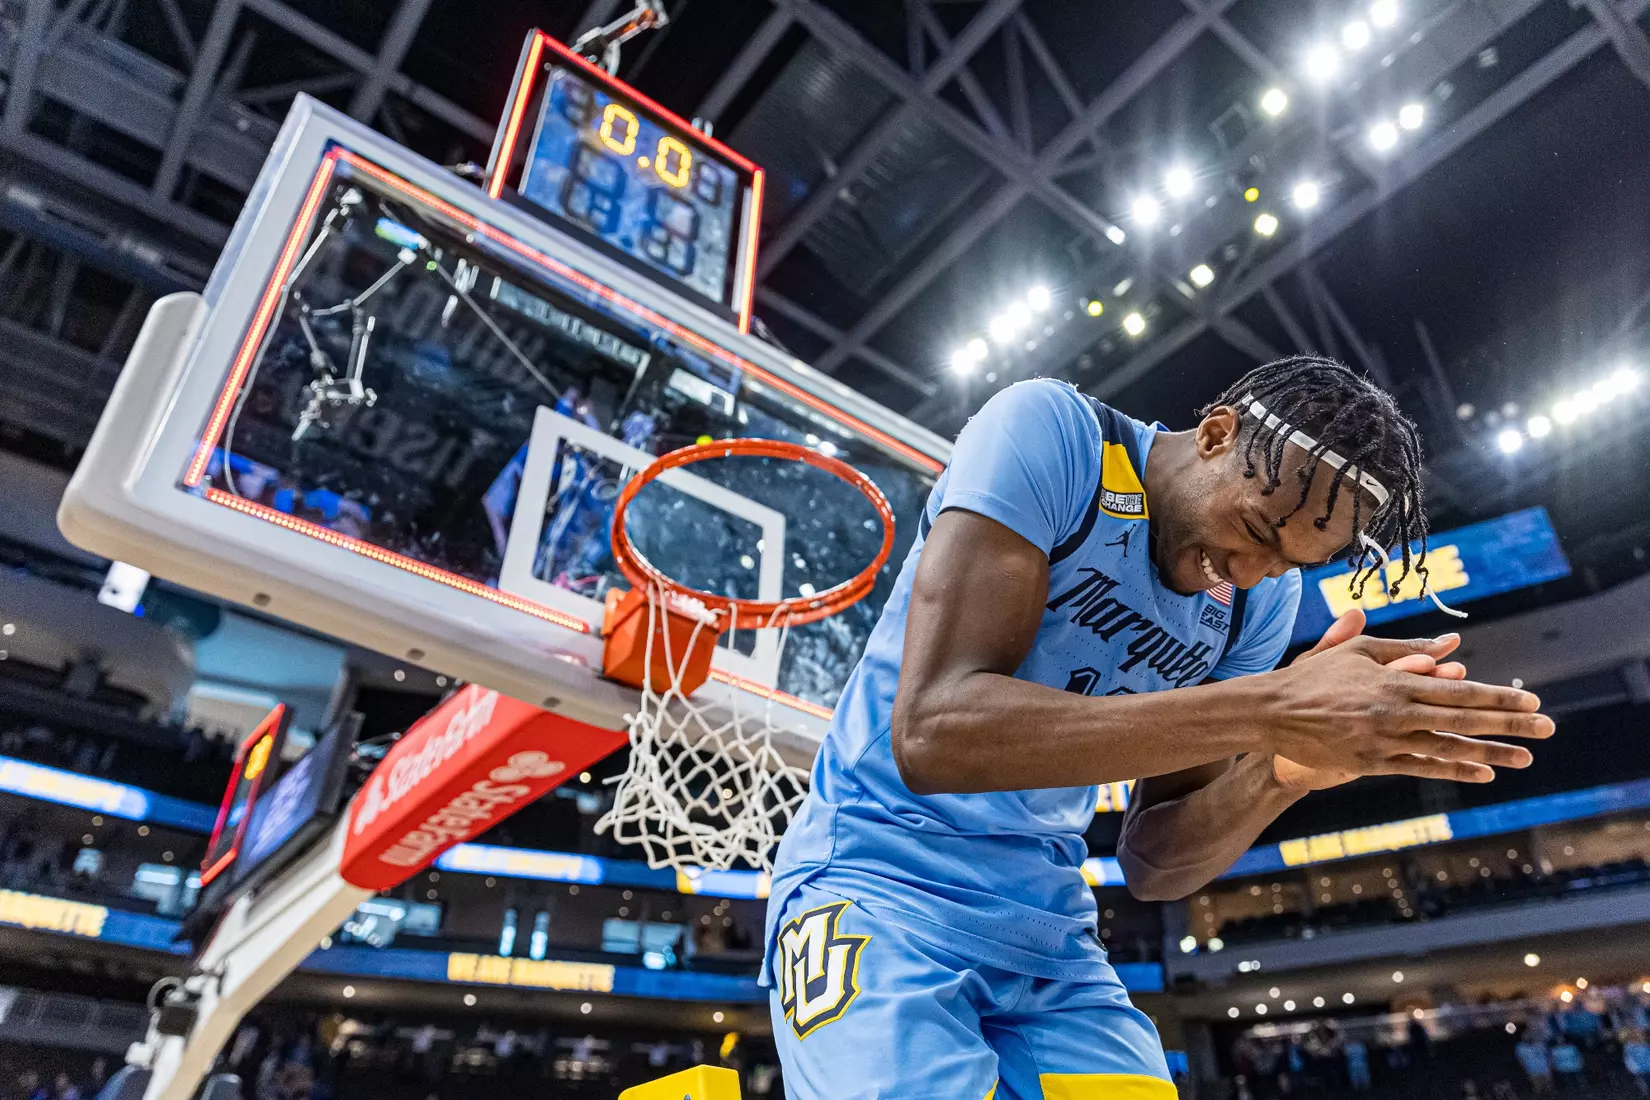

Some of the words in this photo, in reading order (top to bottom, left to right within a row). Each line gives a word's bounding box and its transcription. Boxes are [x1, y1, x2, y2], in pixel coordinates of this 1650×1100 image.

[599, 103, 693, 188] 0.0
[1101, 499, 1143, 513] CHANGE
[1105, 491, 1126, 505] BE
[1199, 611, 1231, 631] EAST
[1203, 603, 1227, 620] BIG
[1045, 567, 1213, 688] Marqutte
[777, 900, 872, 1042] MU
